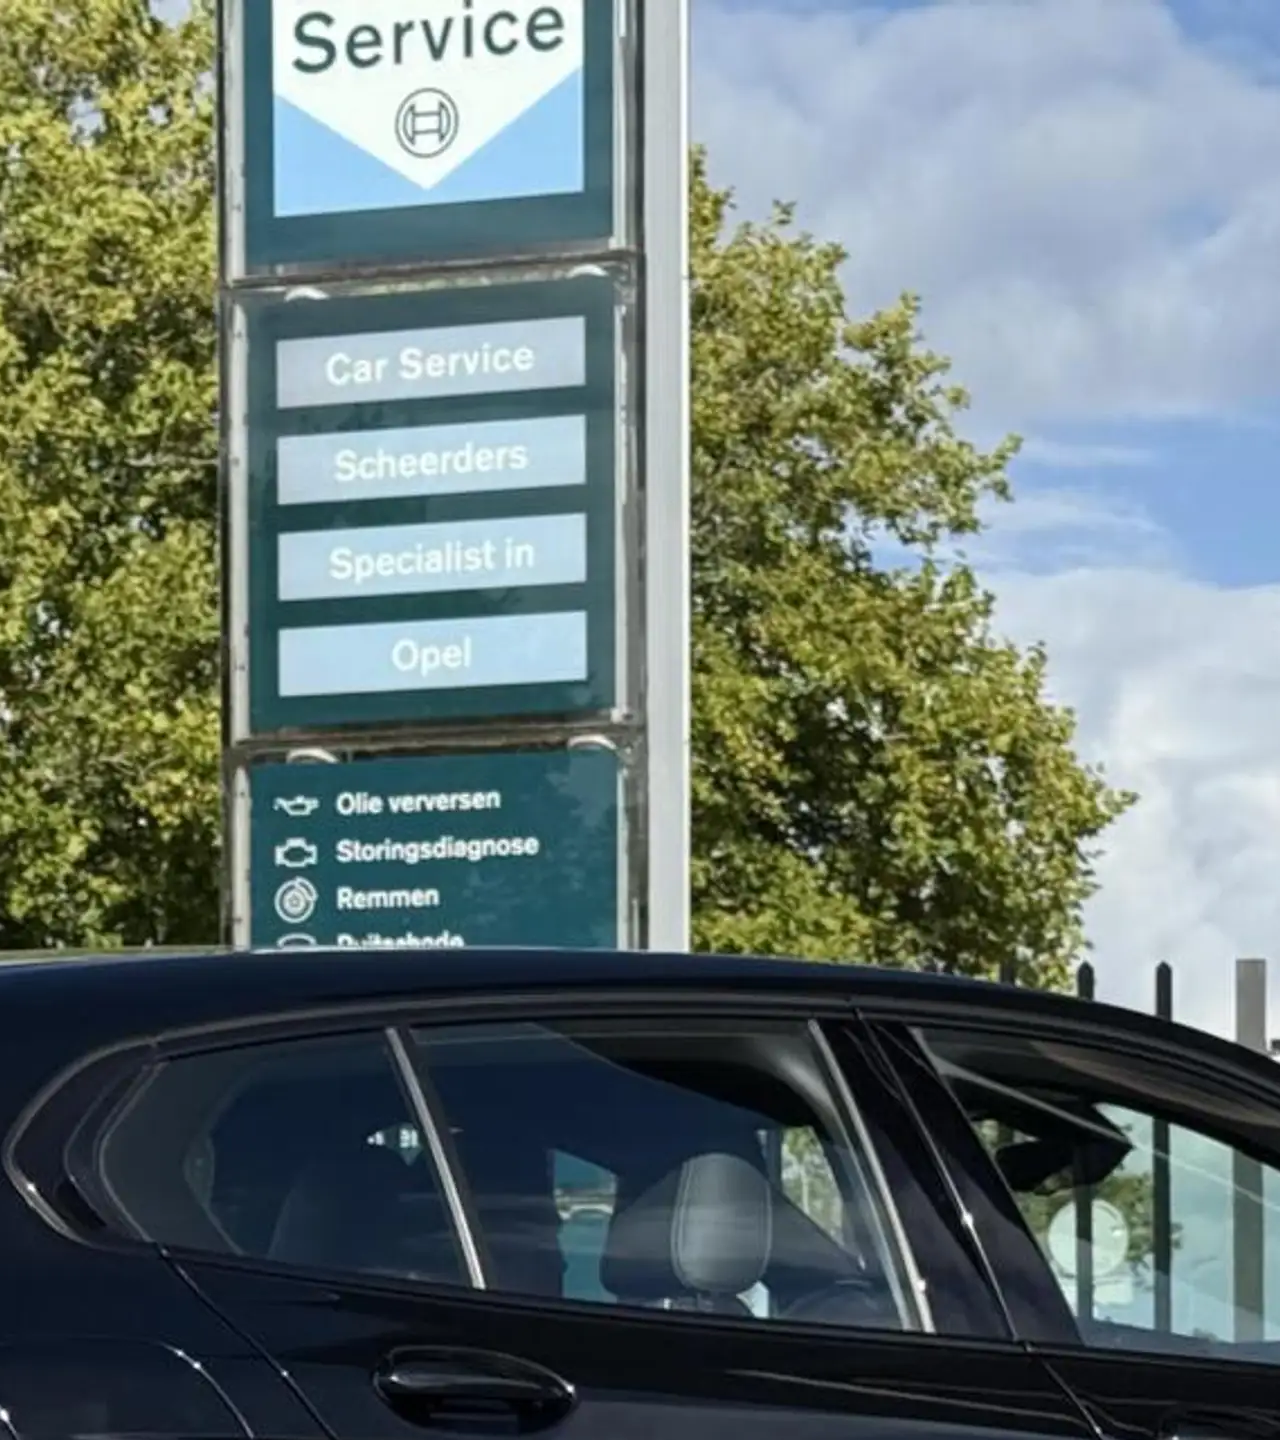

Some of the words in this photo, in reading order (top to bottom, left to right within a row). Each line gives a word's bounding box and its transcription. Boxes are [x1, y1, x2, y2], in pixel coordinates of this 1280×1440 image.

[292, 0, 564, 73] Service
[325, 352, 388, 386] Car
[399, 343, 535, 381] Service
[333, 442, 529, 482] Scheerders
[329, 539, 495, 584] Specialist
[505, 537, 534, 568] in
[391, 636, 471, 677] Opel
[335, 791, 384, 816] Olie
[388, 790, 502, 813] verversen
[335, 836, 540, 864] Storingsdiagnose
[336, 886, 440, 911] Remmen
